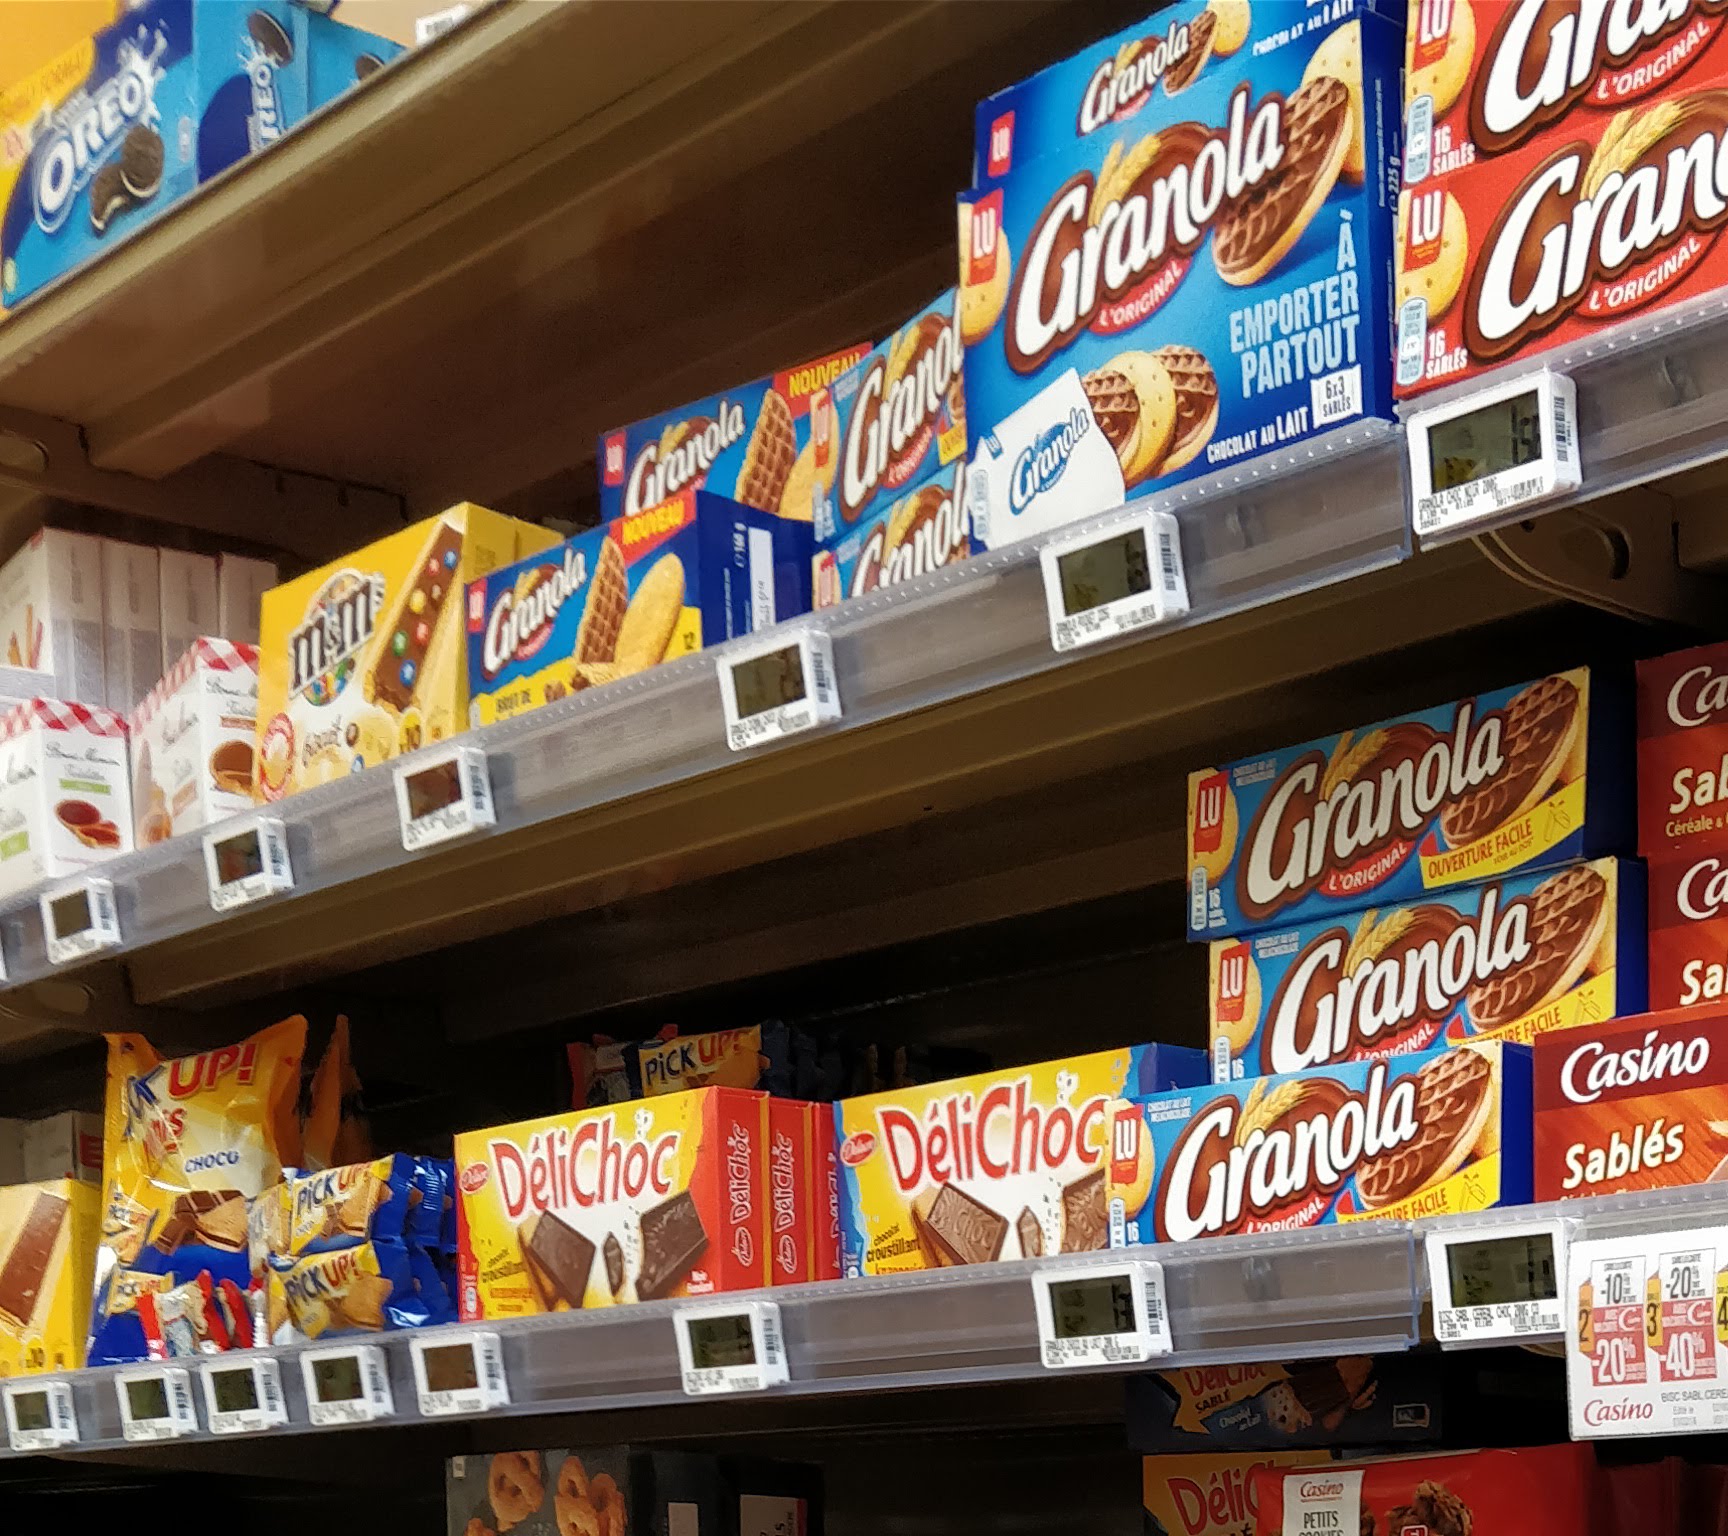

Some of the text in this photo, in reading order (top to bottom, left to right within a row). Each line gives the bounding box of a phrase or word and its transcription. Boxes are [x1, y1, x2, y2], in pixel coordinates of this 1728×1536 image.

[1597, 21, 1710, 99] L'ORIGINAL
[1432, 132, 1452, 156] 16
[974, 205, 996, 256] LU
[1015, 89, 1284, 356] Granola
[1336, 209, 1356, 268] À
[1589, 238, 1701, 310] L'ORIGINAL
[1230, 276, 1359, 353] EMPORTER
[1241, 314, 1361, 398] PARTOUT
[1426, 333, 1446, 356] 16
[1322, 393, 1352, 418] SABLÉS
[1324, 376, 1346, 399] 6x3
[622, 518, 684, 545] NOUVEAU
[484, 545, 586, 676] Granola
[1200, 786, 1224, 827] LU
[1247, 704, 1504, 905] Granola
[1666, 812, 1712, 838] Céréale
[1220, 955, 1245, 998] LU
[1269, 888, 1532, 1076] Granola
[1115, 1116, 1138, 1156] LU
[1163, 1062, 1418, 1242] Granola
[490, 1116, 682, 1217] DéliChoc
[1579, 1308, 1591, 1343] 2
[1646, 1302, 1660, 1338] 3
[1301, 1480, 1343, 1498] Casino
[1303, 1510, 1339, 1530] PETITS
